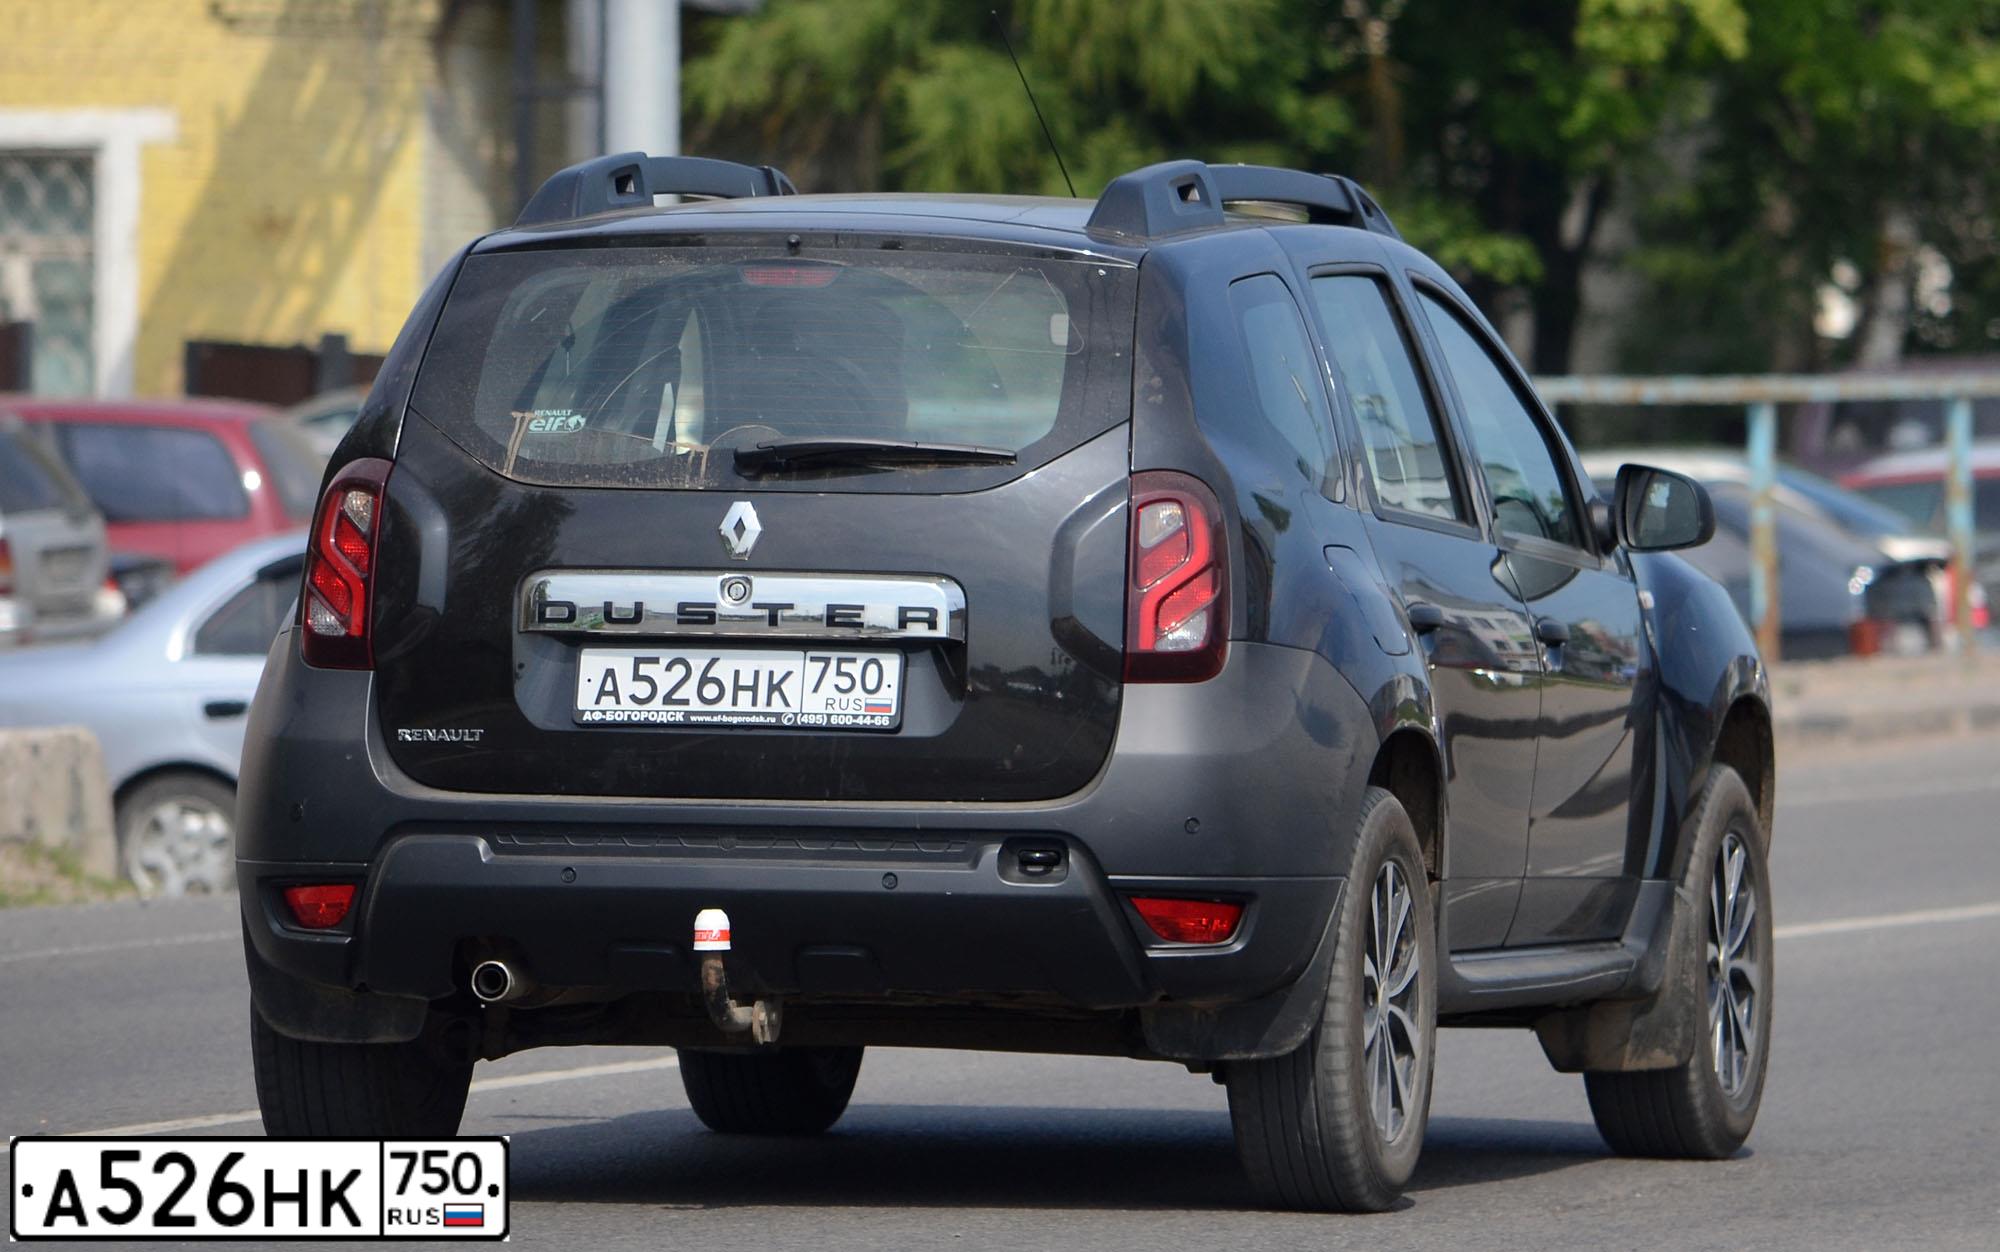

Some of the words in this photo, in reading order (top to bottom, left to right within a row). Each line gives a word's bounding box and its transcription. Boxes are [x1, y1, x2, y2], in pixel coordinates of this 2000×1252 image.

[528, 416, 566, 432] elf
[537, 601, 939, 630] DUSTER
[809, 656, 884, 695] 750
[825, 697, 863, 711] RUS
[582, 710, 685, 723] АФ-БОГОРОДСК
[690, 714, 776, 724] www.af-bogorodsk.ru
[796, 713, 827, 725] (495)
[830, 714, 890, 726] 600-44-66
[398, 728, 484, 741] RENAULT
